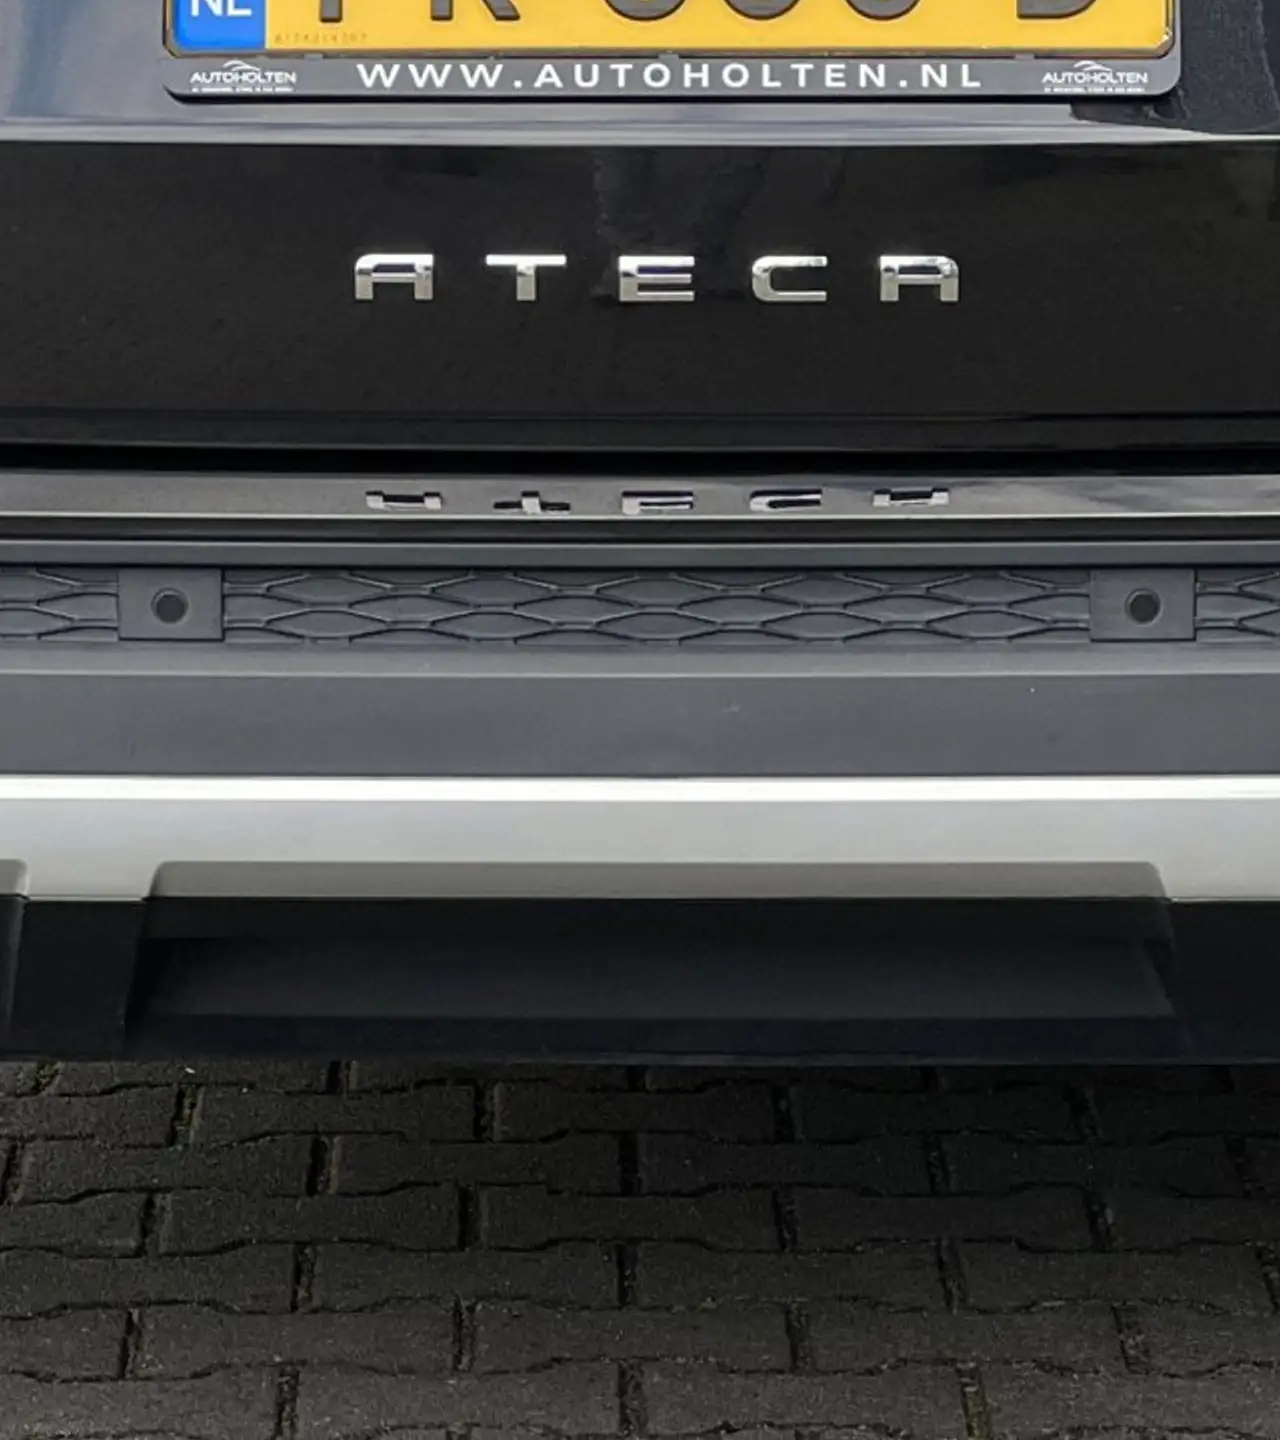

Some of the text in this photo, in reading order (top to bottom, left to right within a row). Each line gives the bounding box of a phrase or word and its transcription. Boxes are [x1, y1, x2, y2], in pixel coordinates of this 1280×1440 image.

[190, 71, 297, 84] AUTOHOLTEN
[357, 63, 982, 88] WWW.AUTOHOLTEN.NL
[1041, 71, 1149, 84] AUTOHOLTEN
[353, 253, 961, 303] ATECA
